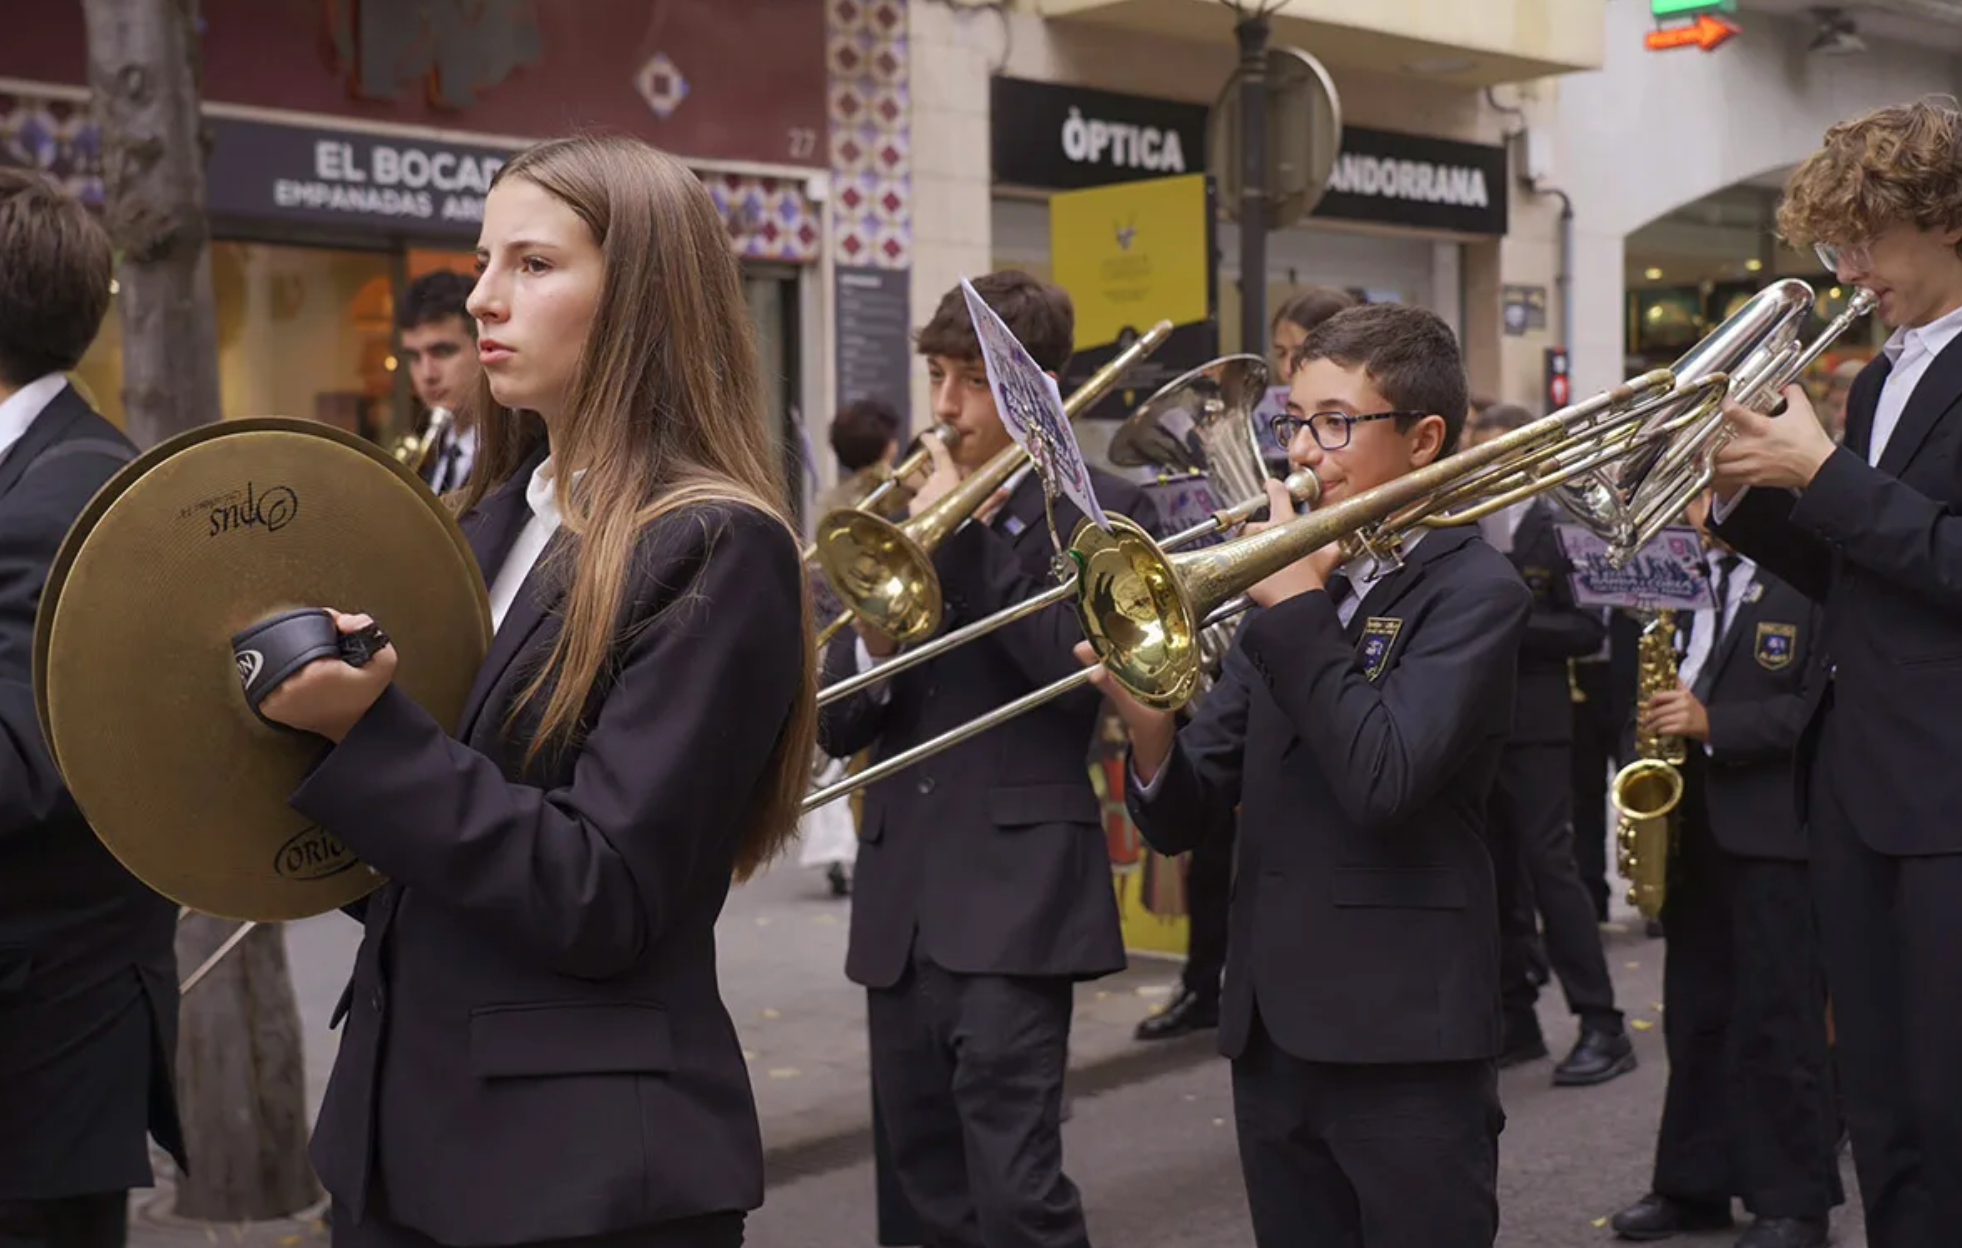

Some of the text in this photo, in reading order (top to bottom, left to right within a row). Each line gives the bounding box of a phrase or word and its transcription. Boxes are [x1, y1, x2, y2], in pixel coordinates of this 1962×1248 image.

[315, 140, 366, 182] EL
[1062, 105, 1488, 208] ÒPTICA ANDORRANA
[275, 178, 485, 221] EMPANADAS AR
[210, 481, 298, 537] Opus
